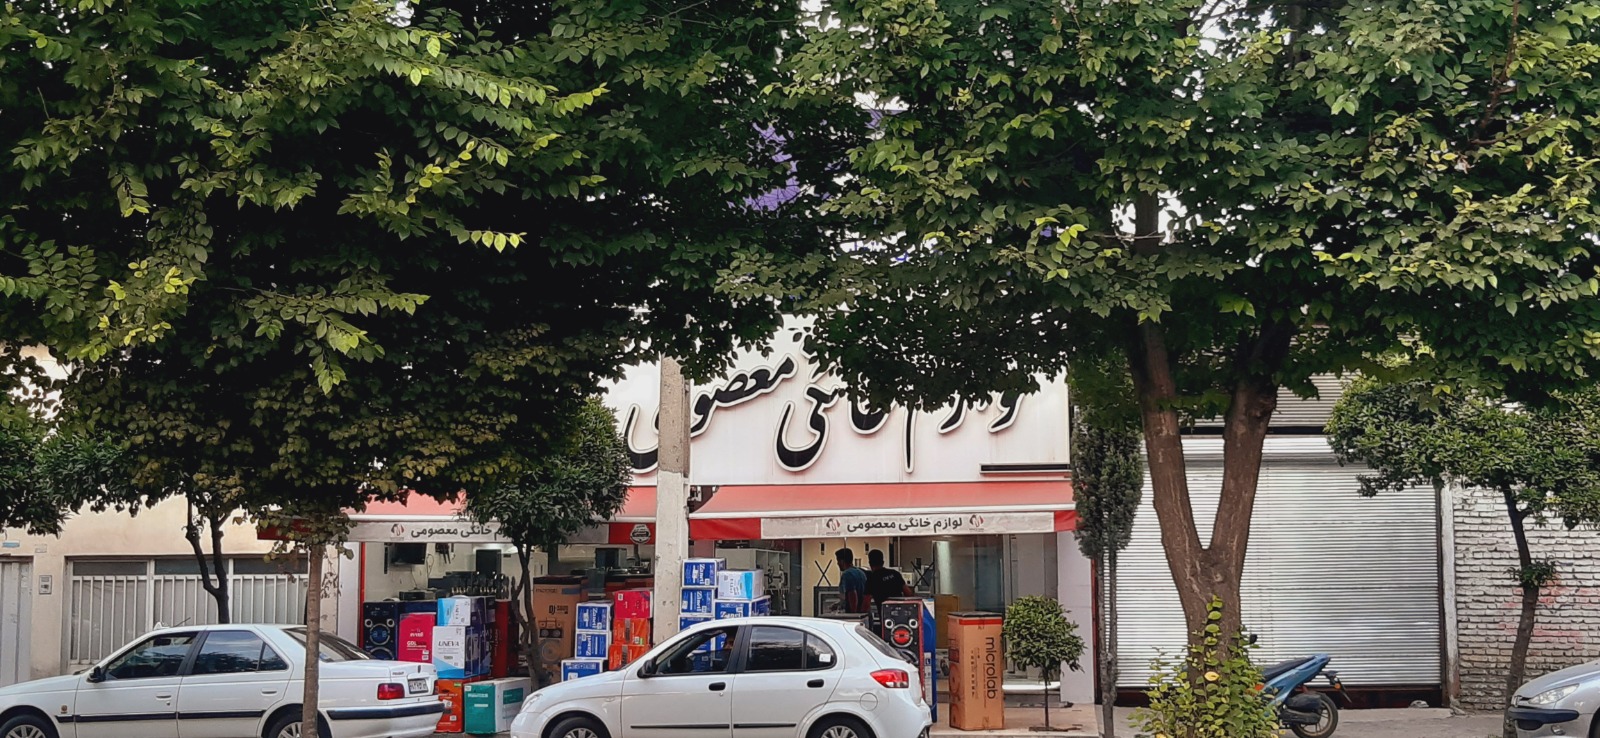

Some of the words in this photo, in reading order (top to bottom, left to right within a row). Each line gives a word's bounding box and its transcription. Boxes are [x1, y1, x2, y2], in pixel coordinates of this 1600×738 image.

[847, 521, 896, 533] معصومی
[898, 517, 931, 532] خانگی
[933, 517, 963, 533] لوازم
[410, 526, 458, 538] معصومی
[461, 525, 493, 539] خانگی
[985, 637, 998, 699] microlab
